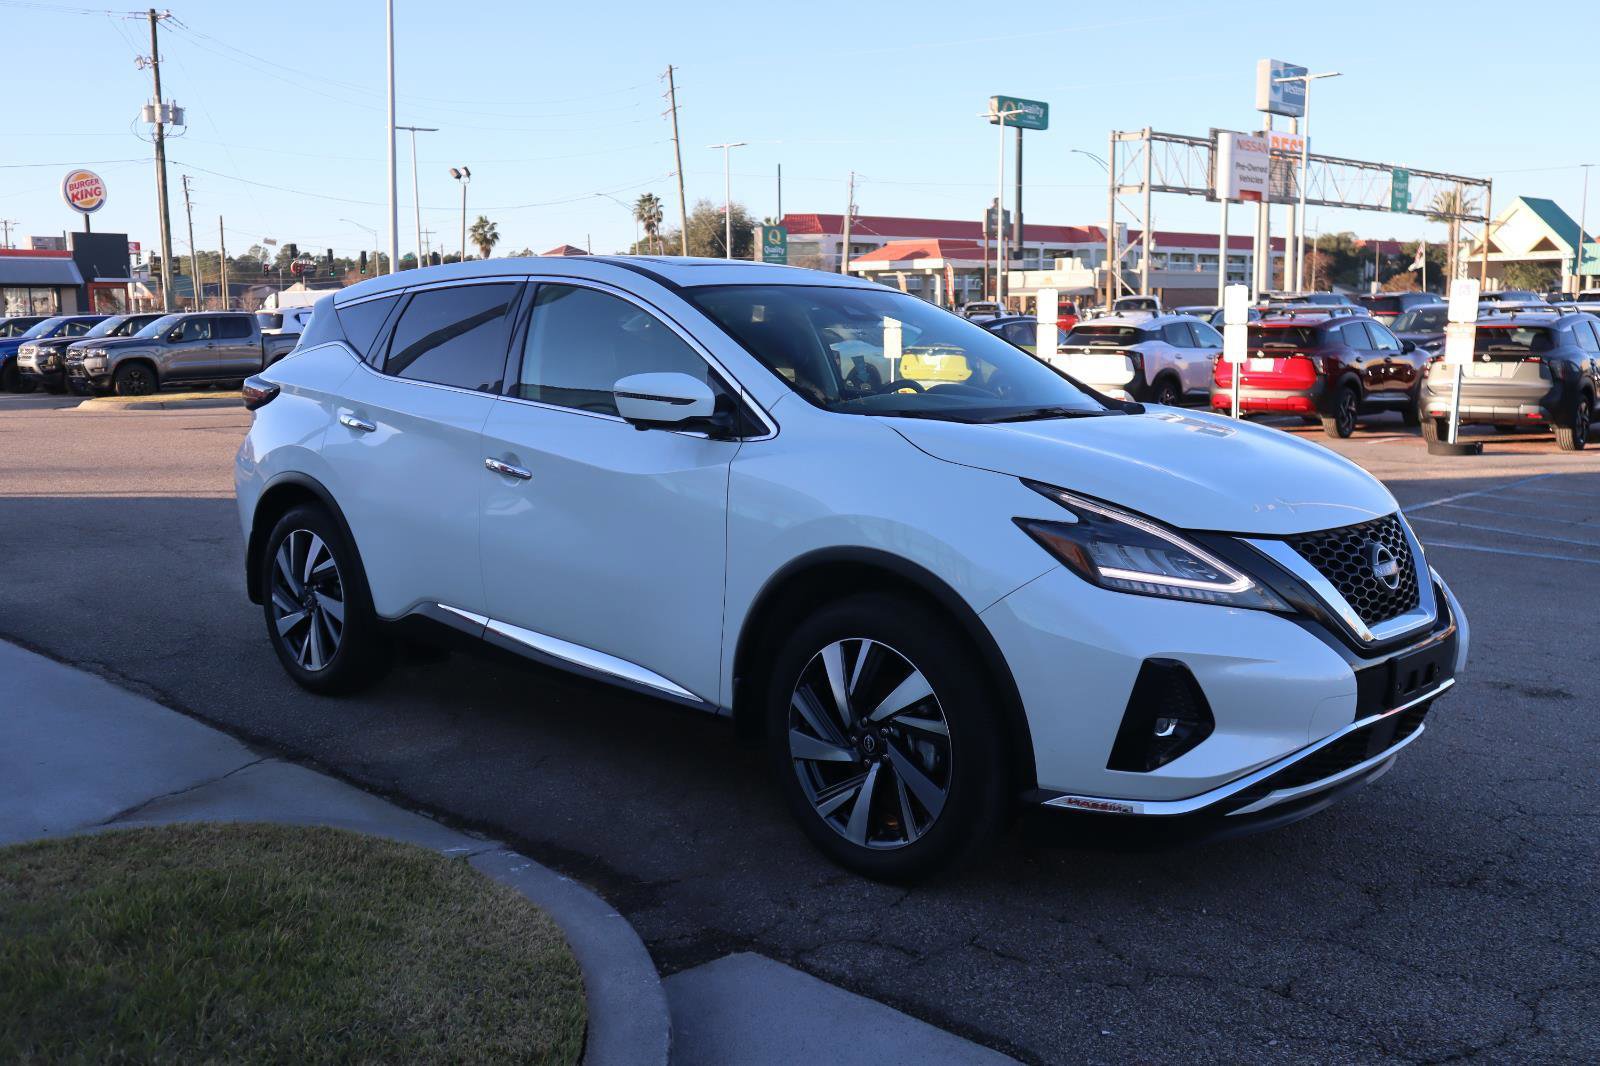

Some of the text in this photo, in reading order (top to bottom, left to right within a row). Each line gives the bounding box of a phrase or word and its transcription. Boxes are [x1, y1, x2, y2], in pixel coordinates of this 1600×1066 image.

[1236, 139, 1268, 154] NISSAN
[1235, 161, 1268, 174] Pre-Owned
[69, 178, 100, 191] BURGER
[1239, 174, 1264, 185] Vehicles
[71, 186, 102, 203] KING
[764, 245, 785, 257] Quality
